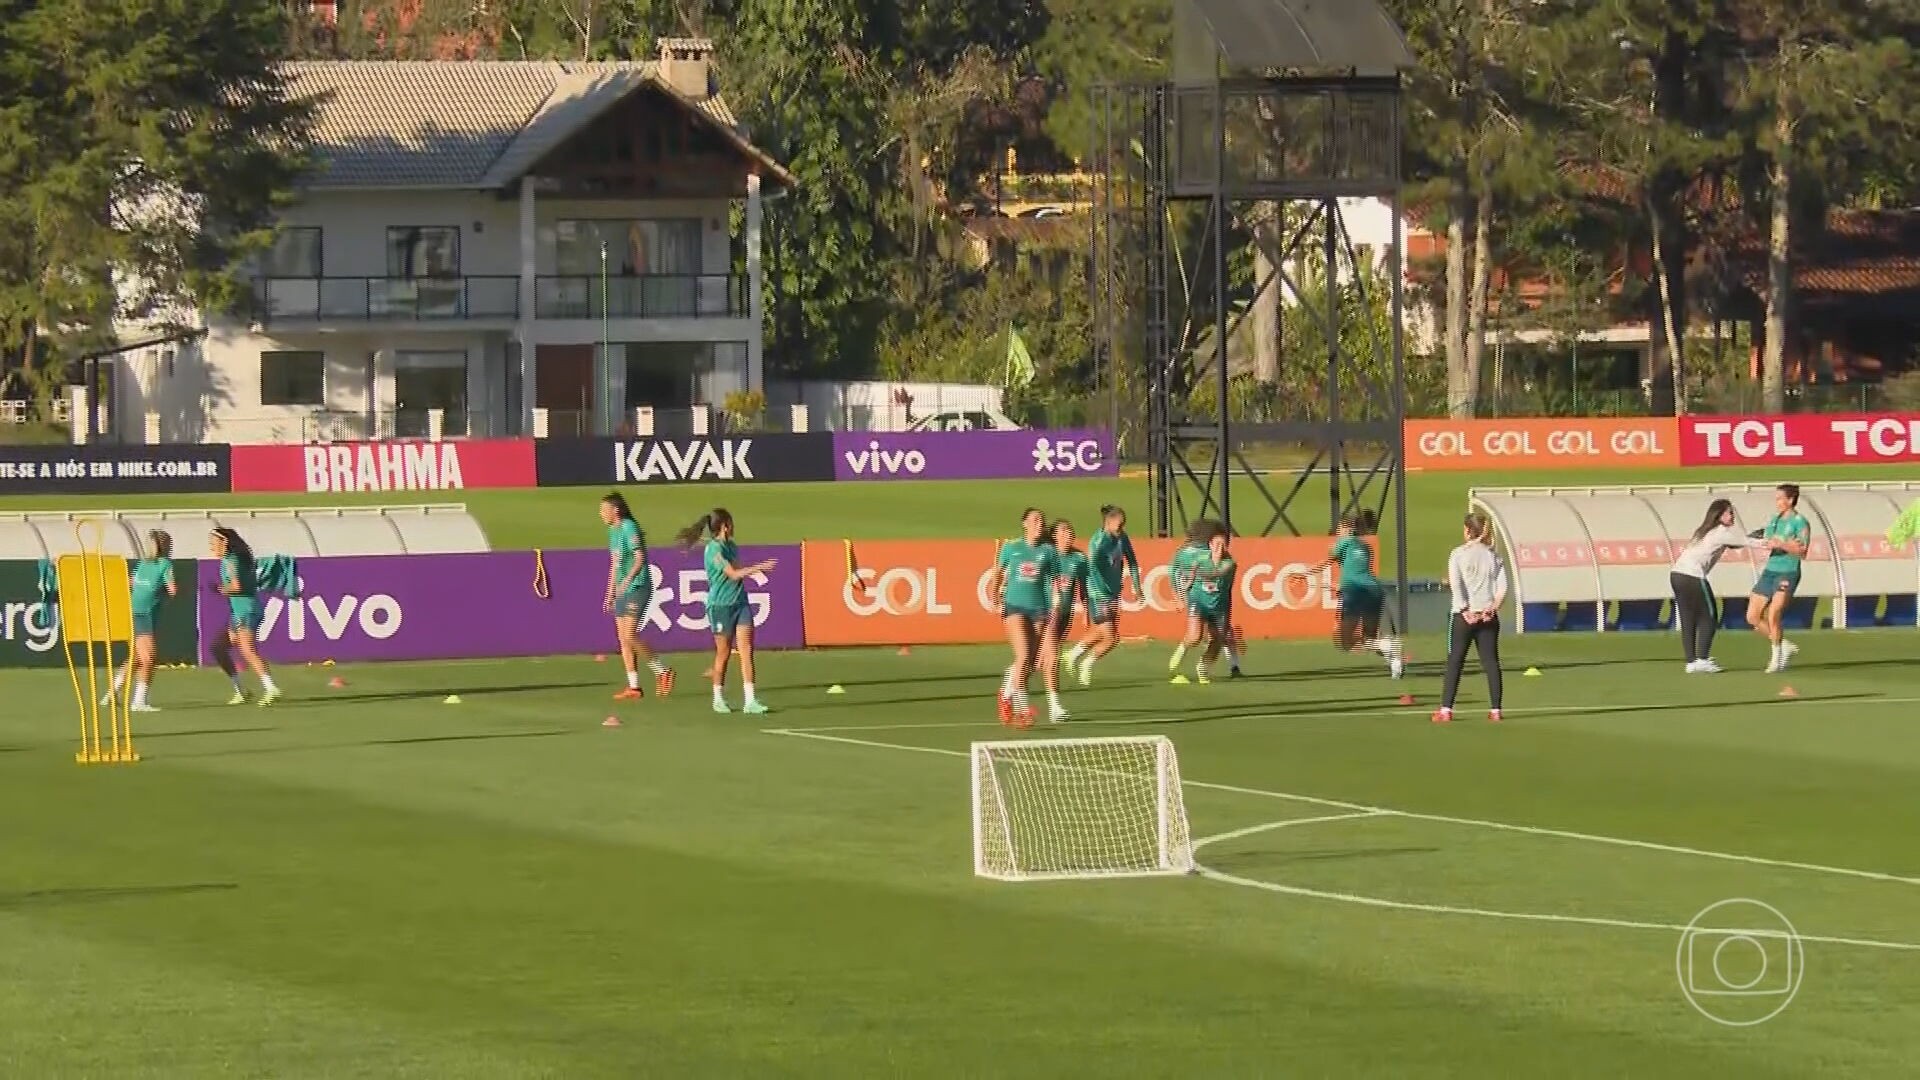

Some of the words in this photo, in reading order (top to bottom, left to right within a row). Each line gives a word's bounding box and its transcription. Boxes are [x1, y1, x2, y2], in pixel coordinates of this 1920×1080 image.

[844, 440, 926, 474] vivo
[1055, 440, 1102, 472] 5G
[1419, 431, 1472, 456] GOL
[1483, 431, 1536, 454] GOL
[1547, 430, 1600, 454] GOL
[1610, 430, 1664, 454] GOL
[1693, 420, 1804, 458] TCL
[40, 462, 51, 478] A
[55, 458, 86, 478] NÓS
[90, 461, 114, 478] EM
[117, 461, 218, 478] NIKE.COM.BR
[304, 442, 464, 492] BRAHMA
[615, 440, 754, 482] KAVAK
[255, 576, 403, 642] vivo
[842, 567, 953, 616] GOL
